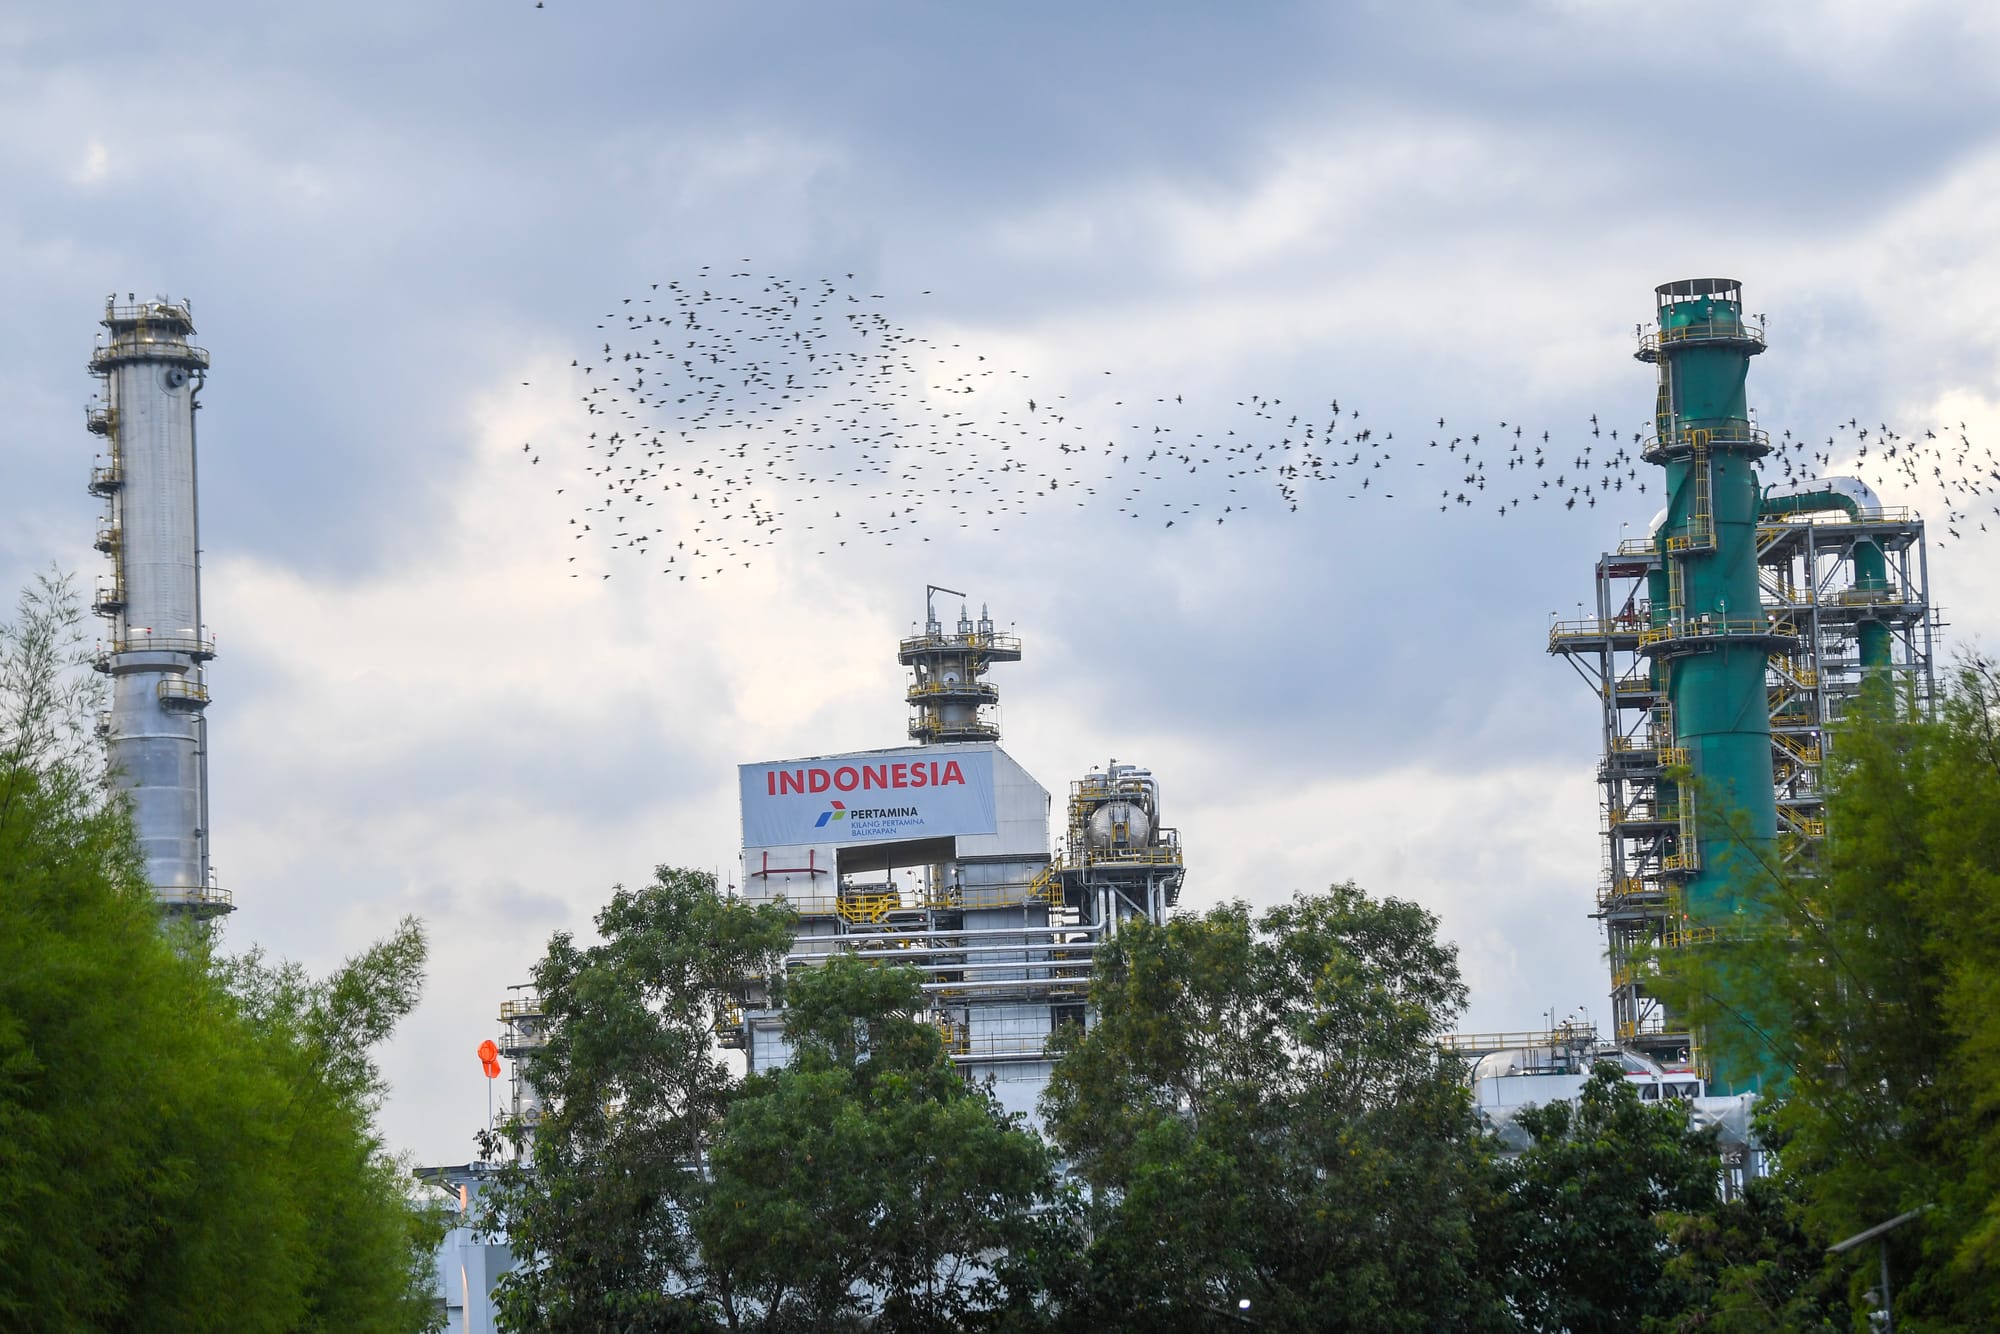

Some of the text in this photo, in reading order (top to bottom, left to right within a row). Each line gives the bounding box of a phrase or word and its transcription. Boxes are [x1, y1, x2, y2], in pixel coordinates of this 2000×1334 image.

[767, 761, 966, 796] INDONESIA
[851, 807, 918, 819] PERTAMINA
[851, 819, 925, 829] KILANG PERTAMINA
[851, 828, 897, 837] BALIKPAPAN
